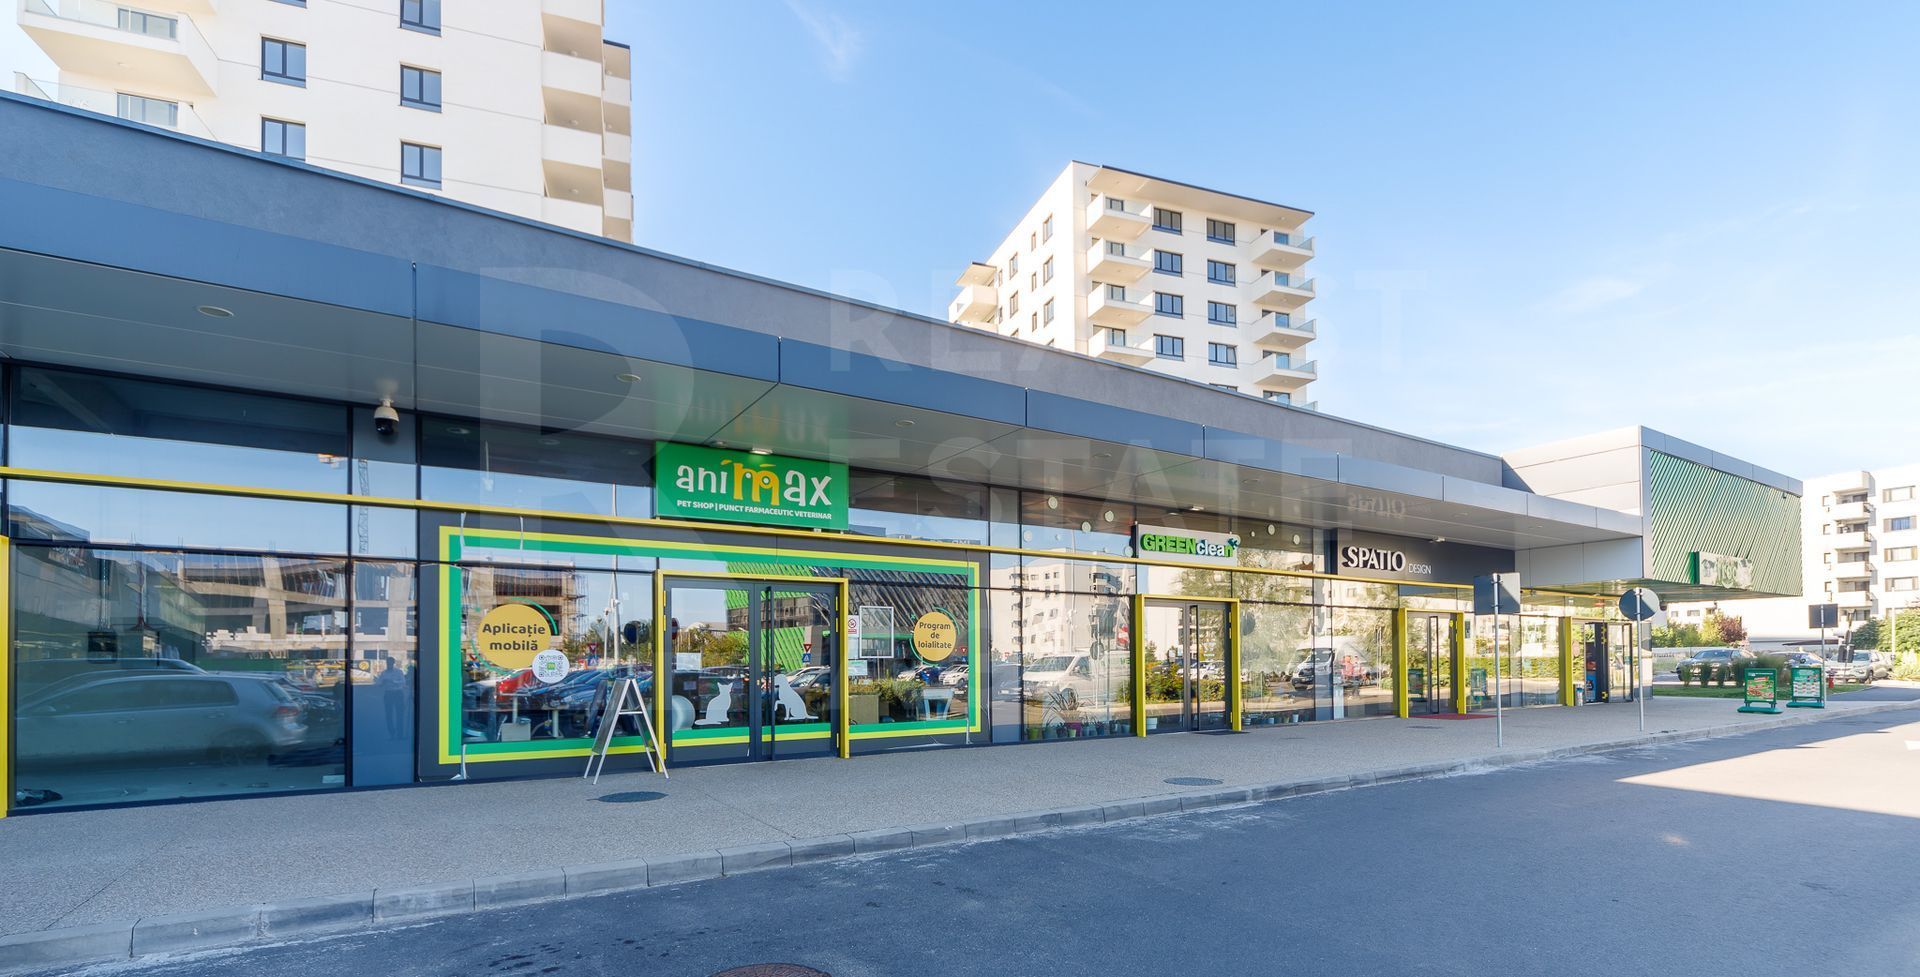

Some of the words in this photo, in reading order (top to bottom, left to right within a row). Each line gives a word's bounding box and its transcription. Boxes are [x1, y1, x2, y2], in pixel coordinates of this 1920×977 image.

[677, 499, 692, 508] PET
[693, 501, 715, 510] SHOP
[719, 503, 744, 512] PUNCT
[745, 506, 794, 517] FARMACEUTIC
[795, 510, 832, 520] VETERINAR
[1347, 546, 1406, 571] SPATIO
[1408, 563, 1432, 574] DESIGN
[482, 623, 546, 637] Aplicație
[919, 621, 951, 631] Program
[930, 631, 940, 639] de
[489, 640, 538, 651] mobilă
[917, 640, 952, 649] loialitate
